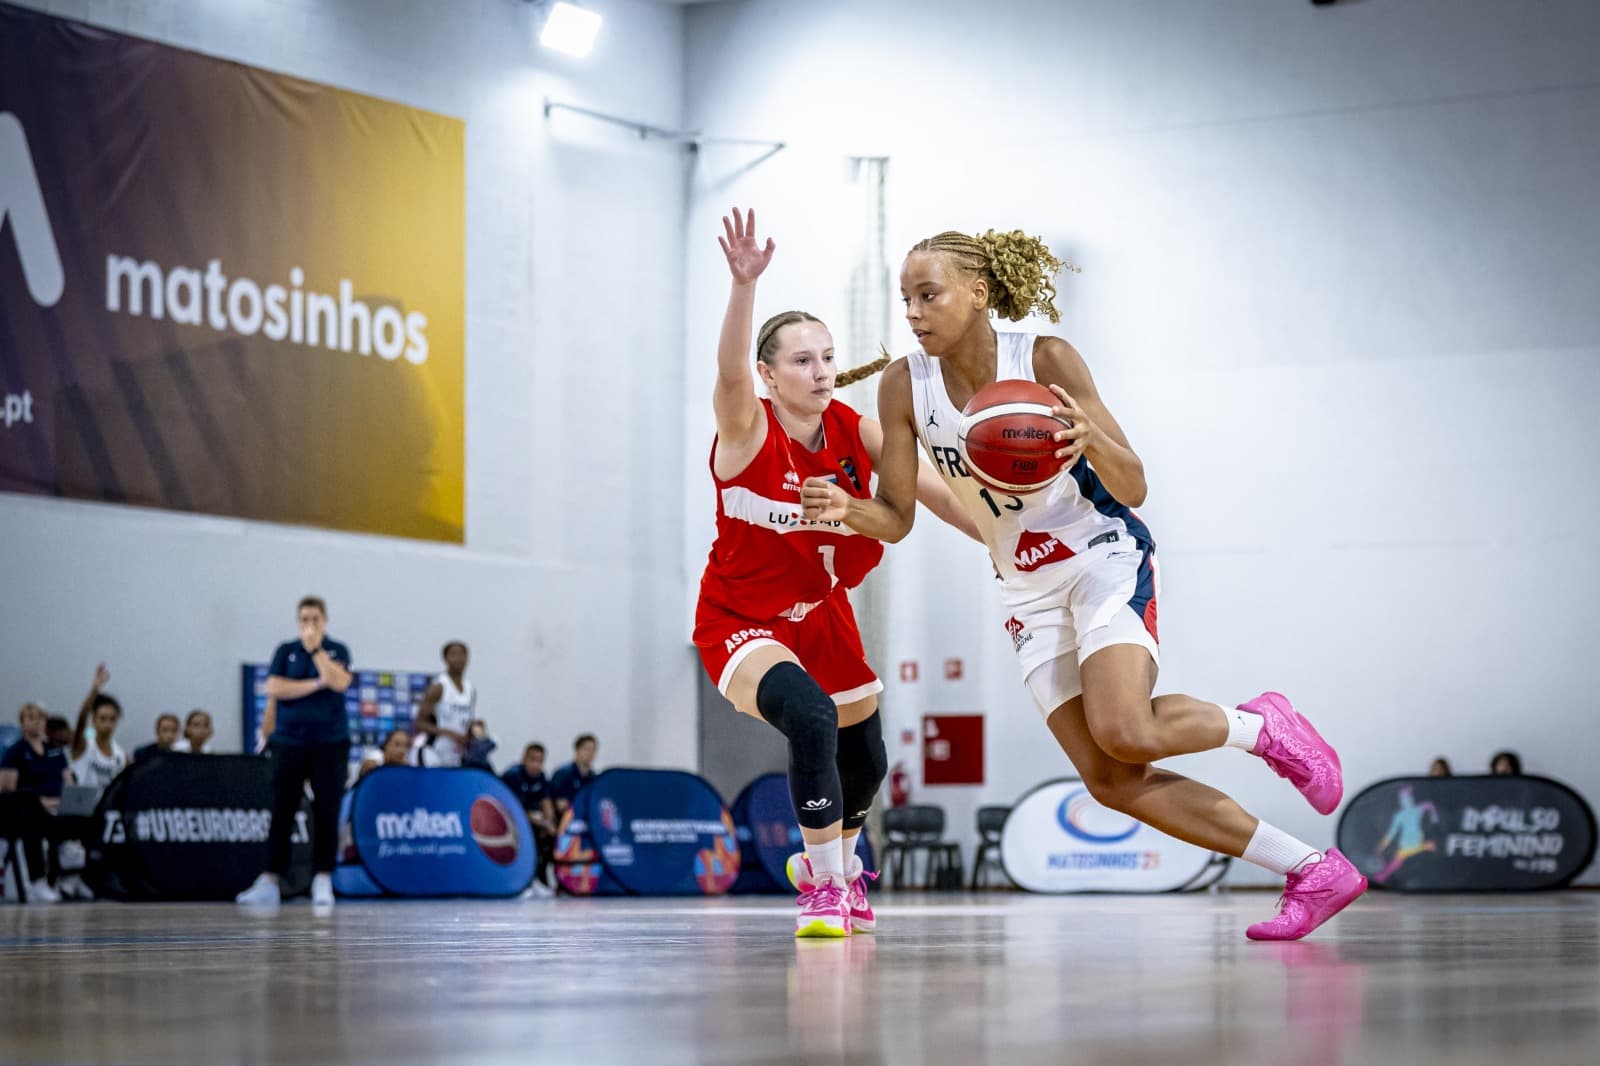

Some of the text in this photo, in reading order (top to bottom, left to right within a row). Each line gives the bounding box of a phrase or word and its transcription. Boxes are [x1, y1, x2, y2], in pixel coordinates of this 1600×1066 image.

[106, 254, 428, 364] matosinhos
[1002, 426, 1053, 440] molten
[817, 544, 840, 591] 1
[375, 807, 464, 840] molten
[1462, 805, 1561, 833] IMPULSO
[1446, 832, 1564, 858] FEMININO
[1047, 851, 1137, 869] MATOSINHOS
